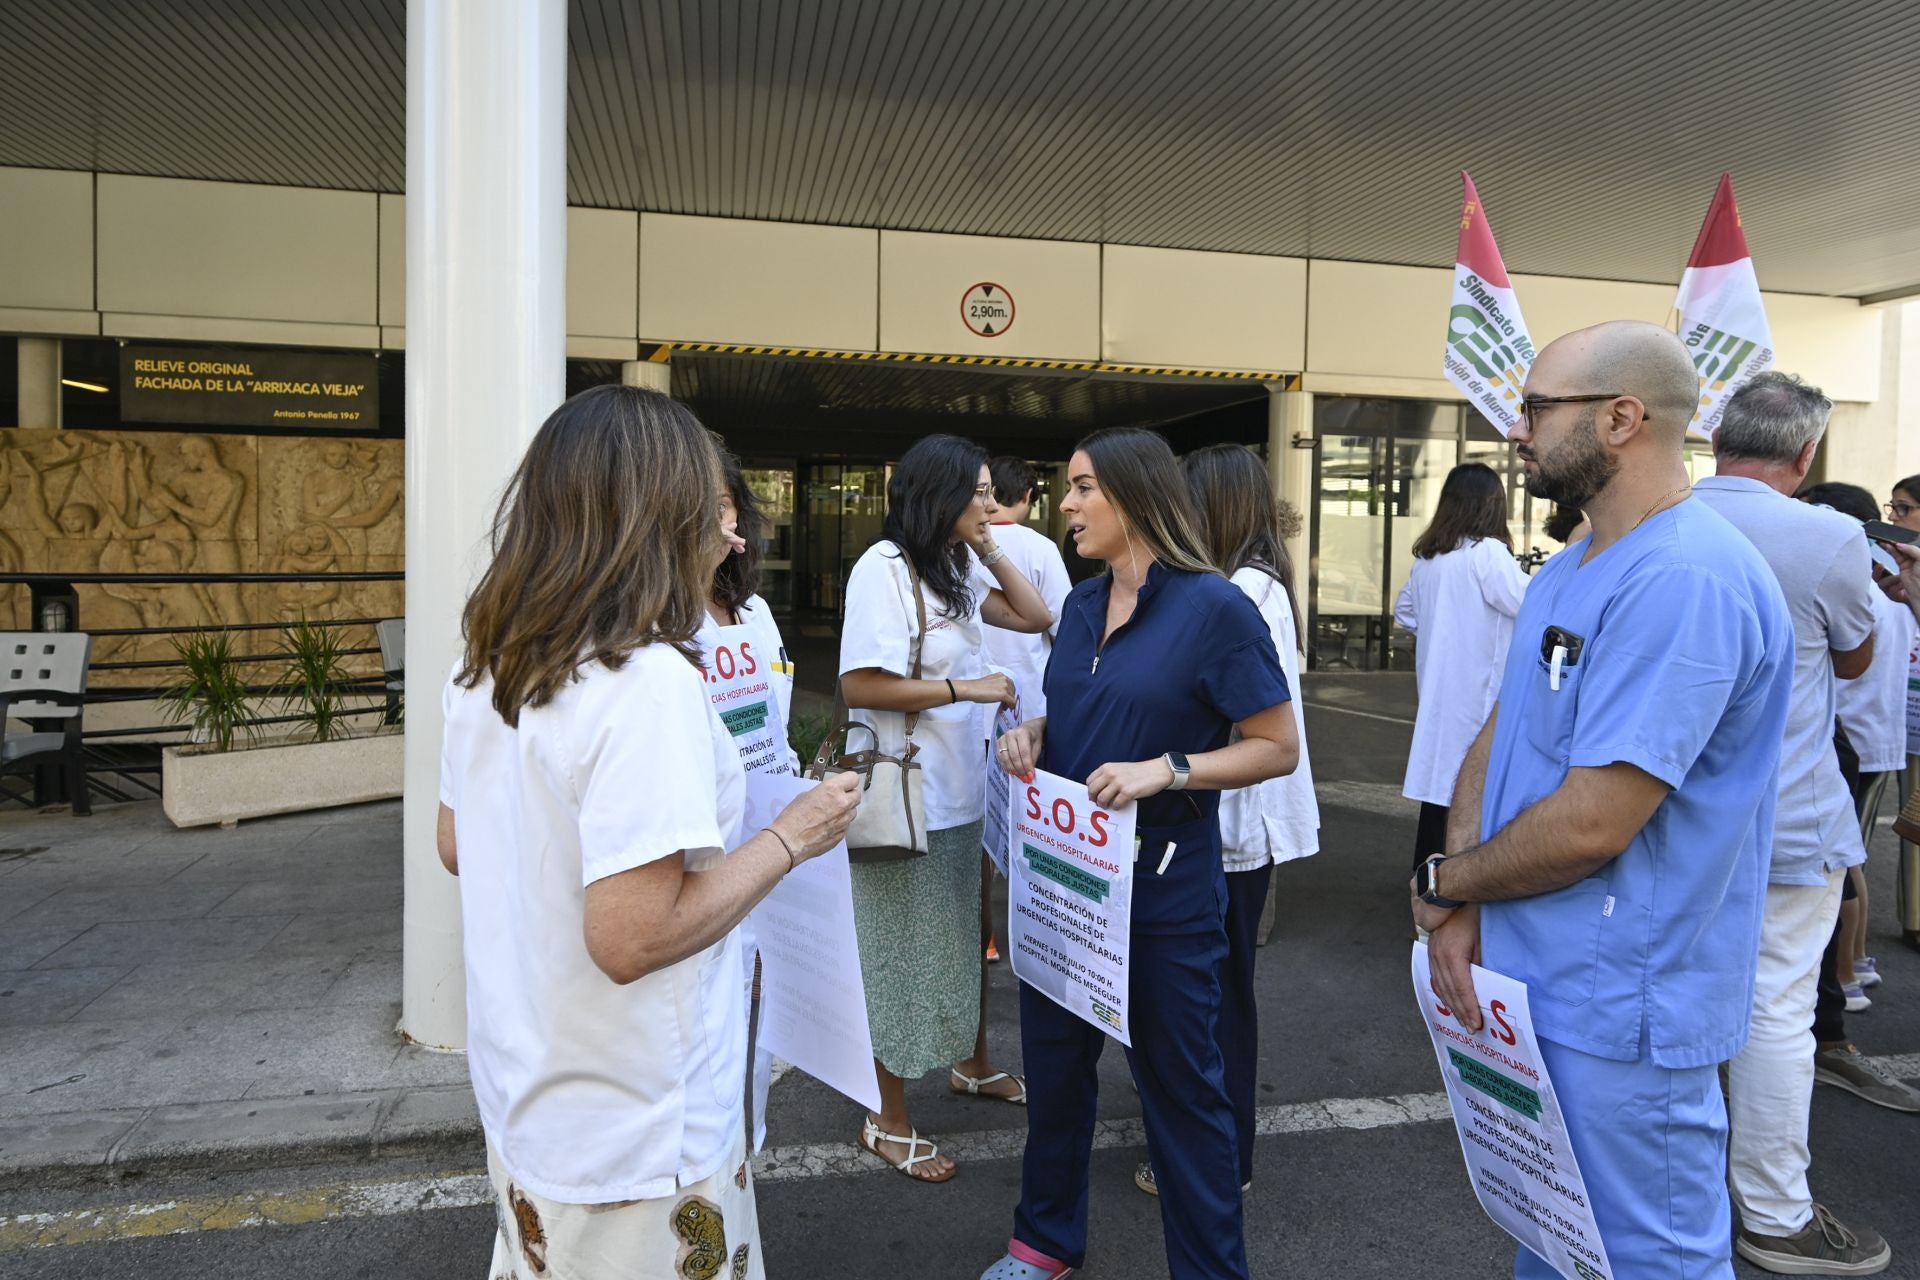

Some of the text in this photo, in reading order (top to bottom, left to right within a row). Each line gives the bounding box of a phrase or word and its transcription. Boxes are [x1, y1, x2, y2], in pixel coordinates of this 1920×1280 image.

[970, 306, 1008, 319] 2,90m.
[1460, 274, 1516, 336] Sindicato
[135, 360, 253, 376] RELIEVE ORIGINAL
[135, 376, 202, 391] FACHADA
[206, 380, 224, 392] DE
[227, 381, 244, 392] LA
[1445, 348, 1515, 429] egión de Murcia
[274, 410, 360, 420] Antonio Penella 1967
[727, 682, 768, 700] HOSPITALARIAS
[733, 706, 766, 722] CONDICIONES
[744, 717, 763, 729] JUSTAS
[744, 752, 776, 772] IONALES DE
[766, 738, 774, 748] DE
[1026, 786, 1110, 847] S.O.S
[1016, 822, 1056, 848] URGENCIAS
[1056, 840, 1120, 874] HOSPITALARIAS
[1026, 848, 1038, 858] POR
[1040, 854, 1058, 868] UNAS
[1058, 863, 1106, 892] CONDICIONES
[1031, 861, 1099, 898] LABORALES JUSTAS
[1028, 882, 1108, 928] CONCENTRACIÓN DE
[1031, 898, 1104, 942] PROFESIONALES DE
[1016, 904, 1122, 966] URGENCIAS HOSPITALARIAS
[1018, 942, 1122, 1007] HOSPITAL MORALES MESEGUER
[1024, 933, 1114, 989] VIERNES 18 DE JULIO 10:00 H.
[1434, 1022, 1475, 1048] URGENCIAS
[1476, 1042, 1539, 1080] HOSPITALARIAS
[1463, 1071, 1534, 1114] LABORALES JUSTAS
[1486, 1071, 1538, 1104] CONDICIONES
[1466, 1098, 1553, 1155] CONCENTRACIÓN DE
[1473, 1118, 1557, 1174] PROFESIONALES DE
[1464, 1127, 1584, 1208] URGENCIAS HOSPITALARIAS
[1479, 1178, 1513, 1208] HOSPITAL
[1514, 1202, 1553, 1234] MORALES
[1554, 1228, 1603, 1267] MESEGUER
[1480, 1166, 1587, 1242] VIERNES 18 DE JULIO 10:00 H.
